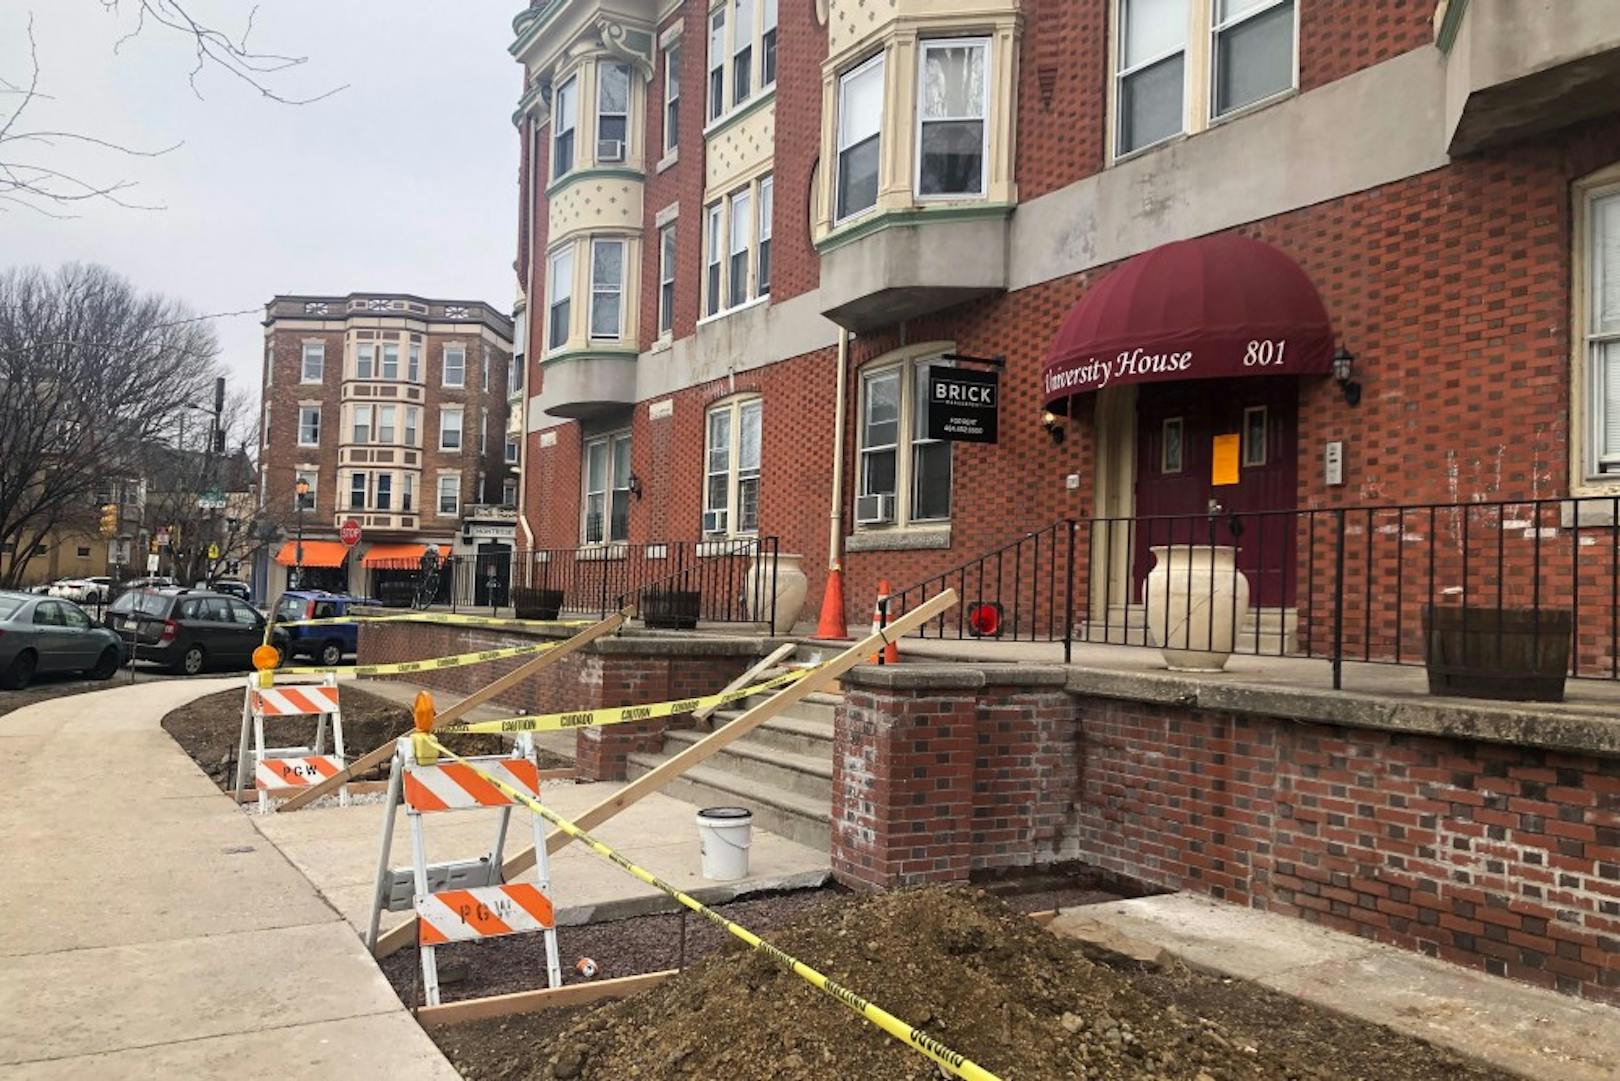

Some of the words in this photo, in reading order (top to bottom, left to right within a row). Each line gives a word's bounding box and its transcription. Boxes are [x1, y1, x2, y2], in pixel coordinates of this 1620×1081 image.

[1243, 339, 1286, 367] 801
[1045, 357, 1112, 393] University
[1115, 348, 1193, 378] House
[935, 383, 991, 403] BRICK
[341, 527, 360, 538] STOP
[501, 718, 537, 733] CAUTION
[560, 712, 594, 727] CUIDADO
